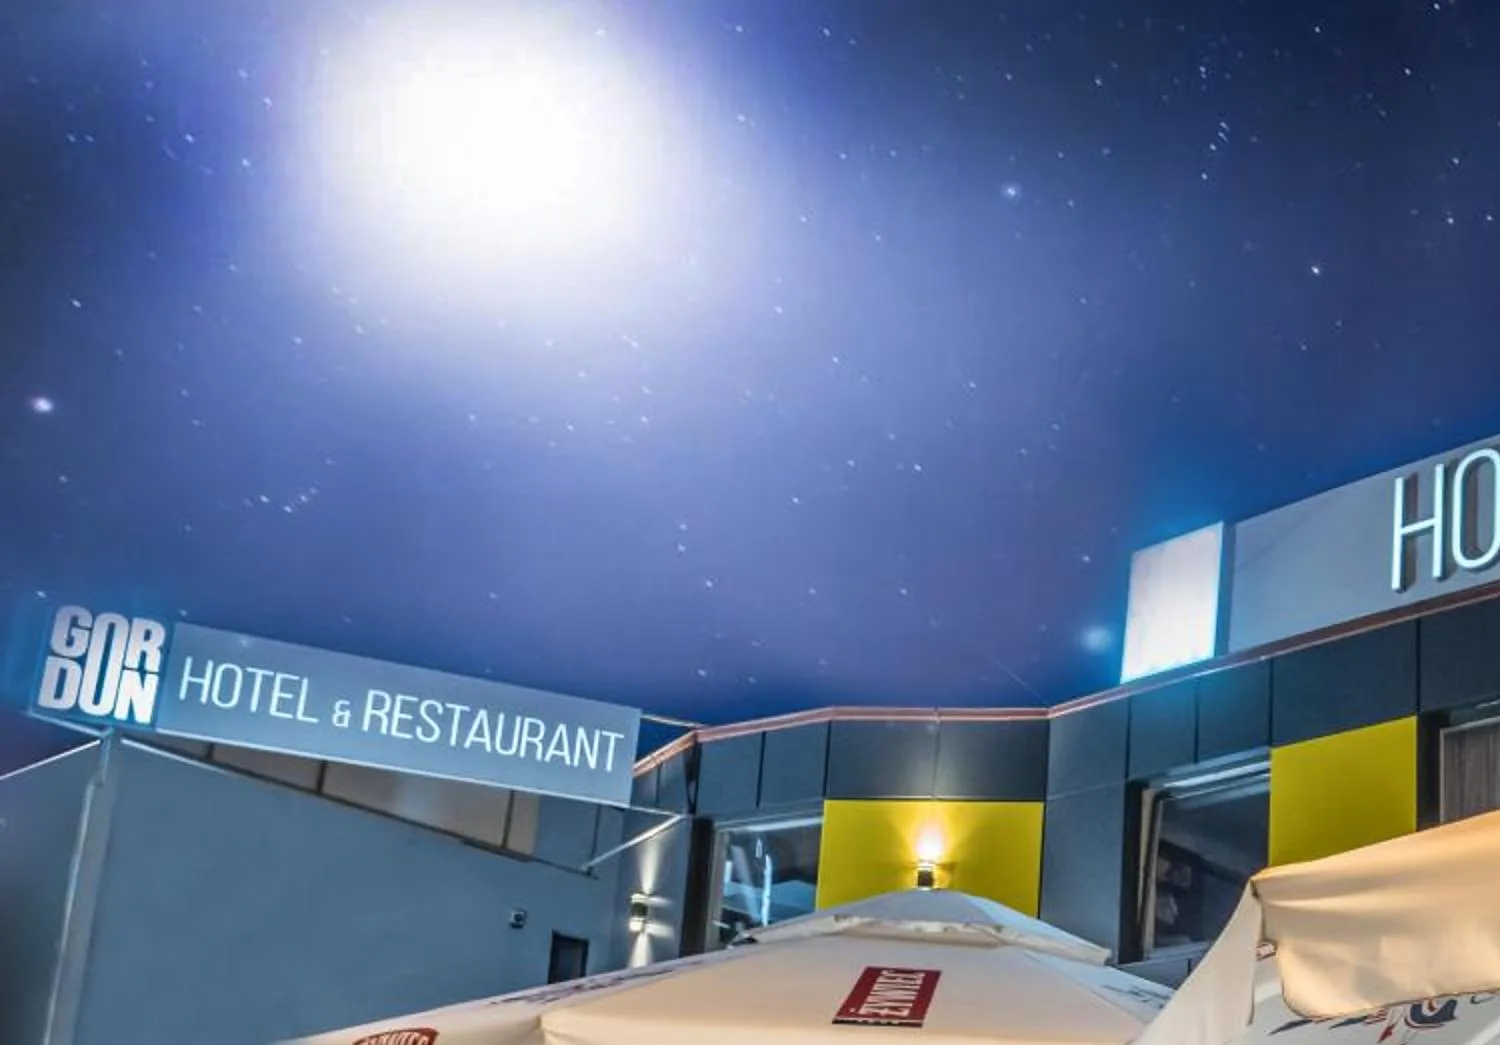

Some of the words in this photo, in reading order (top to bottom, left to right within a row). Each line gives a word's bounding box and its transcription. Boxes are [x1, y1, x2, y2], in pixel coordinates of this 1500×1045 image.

[179, 656, 319, 723] HOTEL
[332, 700, 351, 728] &
[361, 689, 625, 773] RESTAURANT
